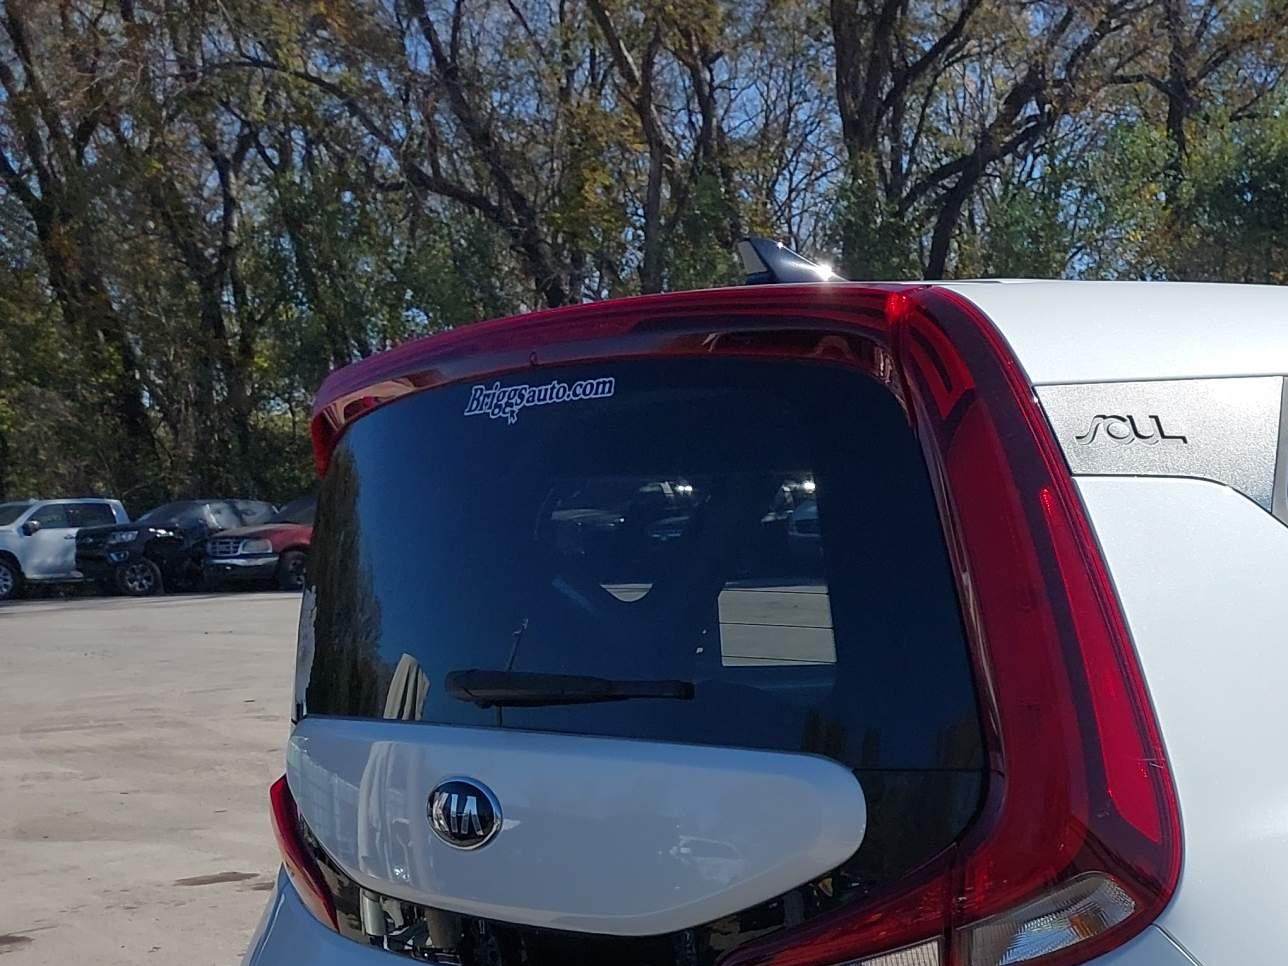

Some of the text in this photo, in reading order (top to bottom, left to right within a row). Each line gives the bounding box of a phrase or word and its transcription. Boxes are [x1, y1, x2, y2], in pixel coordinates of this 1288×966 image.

[463, 377, 616, 422] Briggsauto.com
[1075, 414, 1188, 445] SOUL
[432, 791, 484, 836] KIA
